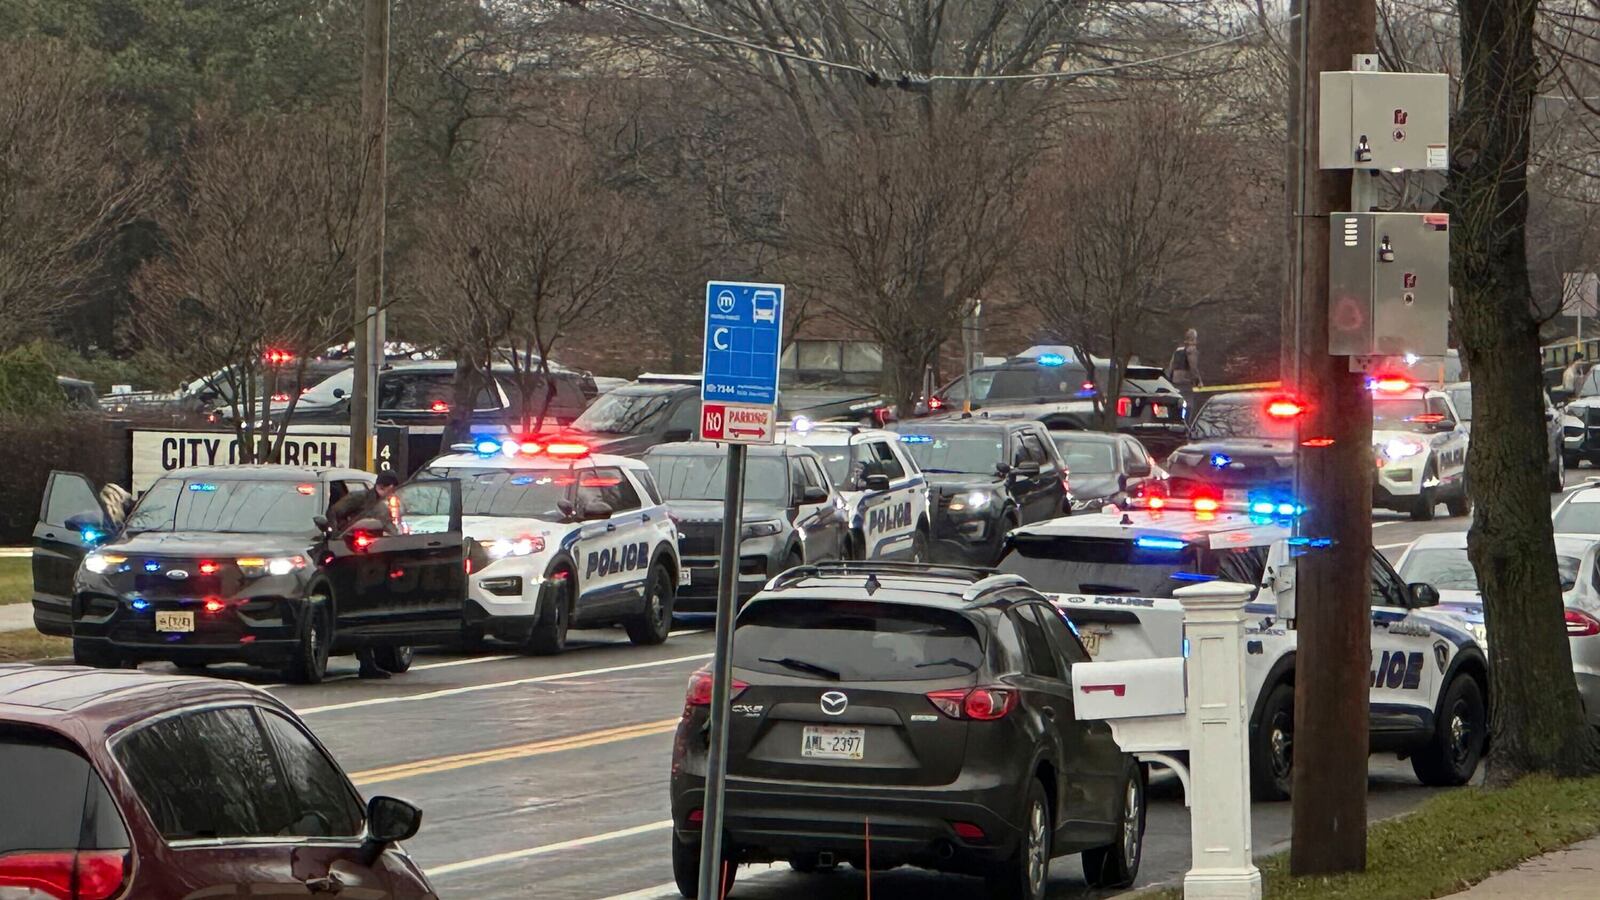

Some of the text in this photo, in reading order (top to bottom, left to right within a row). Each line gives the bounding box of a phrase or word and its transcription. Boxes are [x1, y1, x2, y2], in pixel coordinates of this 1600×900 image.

[713, 327, 729, 351] C
[705, 412, 722, 432] NO
[728, 409, 768, 426] PARKING
[162, 437, 337, 470] CITY CHRCH
[869, 502, 912, 537] POLICE
[586, 541, 649, 580] POLICE
